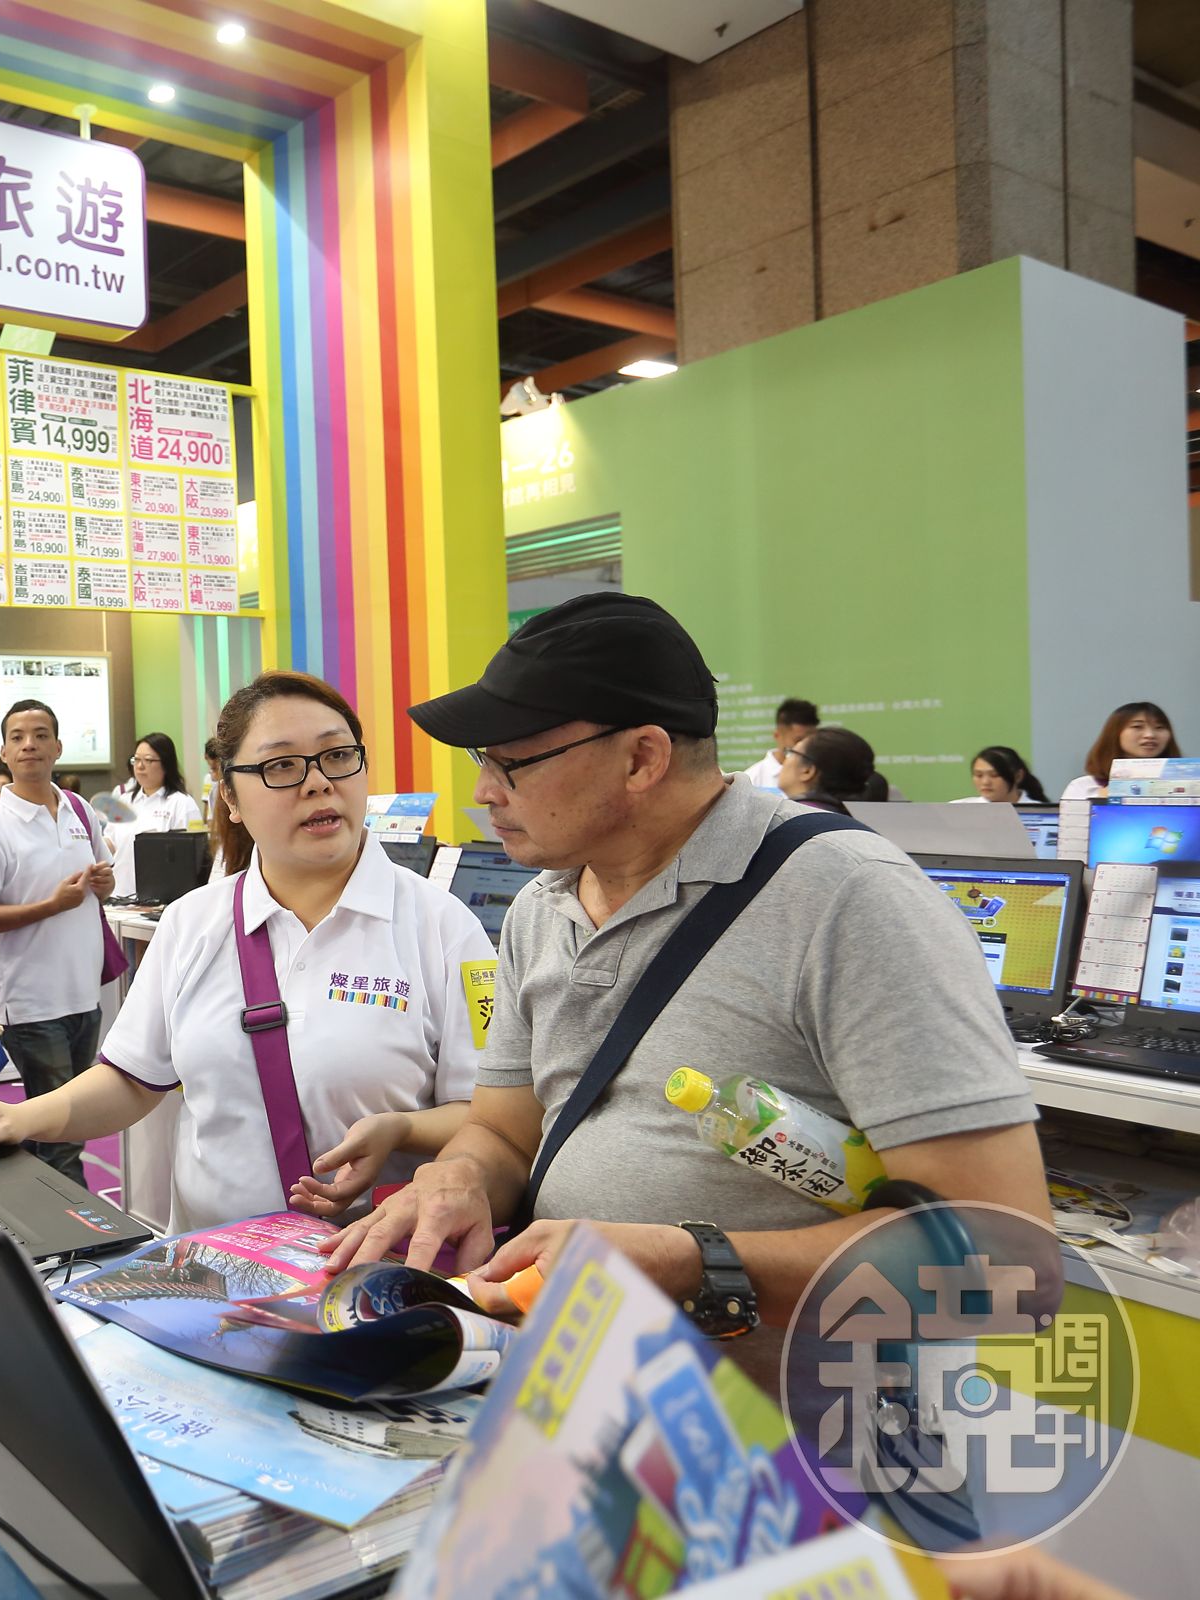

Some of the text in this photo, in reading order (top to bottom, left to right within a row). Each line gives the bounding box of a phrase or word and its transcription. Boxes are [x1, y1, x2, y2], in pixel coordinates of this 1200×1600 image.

[8, 358, 37, 445] 菲律賓
[128, 378, 153, 460] 北海道
[42, 423, 110, 454] 14,999
[157, 437, 223, 465] 24,900
[71, 467, 85, 499] 泰國
[130, 472, 142, 504] 東京
[28, 490, 61, 503] 24,900
[87, 497, 116, 509] 19,999
[185, 478, 199, 509] 大阪
[145, 502, 175, 513] 20,900
[200, 506, 229, 518] 23,999
[31, 542, 63, 553] 18,900
[187, 525, 200, 556] 東京
[90, 546, 120, 558] 21,999
[147, 551, 176, 562] 27,900
[203, 554, 230, 565] 13,900
[77, 567, 92, 600] 泰國
[134, 570, 148, 602] 大阪
[32, 594, 65, 605] 29,900
[94, 596, 124, 607] 18,999
[151, 597, 179, 608] 12,999
[205, 600, 232, 611] 12,999
[329, 972, 411, 997] 燦星旅遊
[738, 1137, 845, 1198] 御茶園
